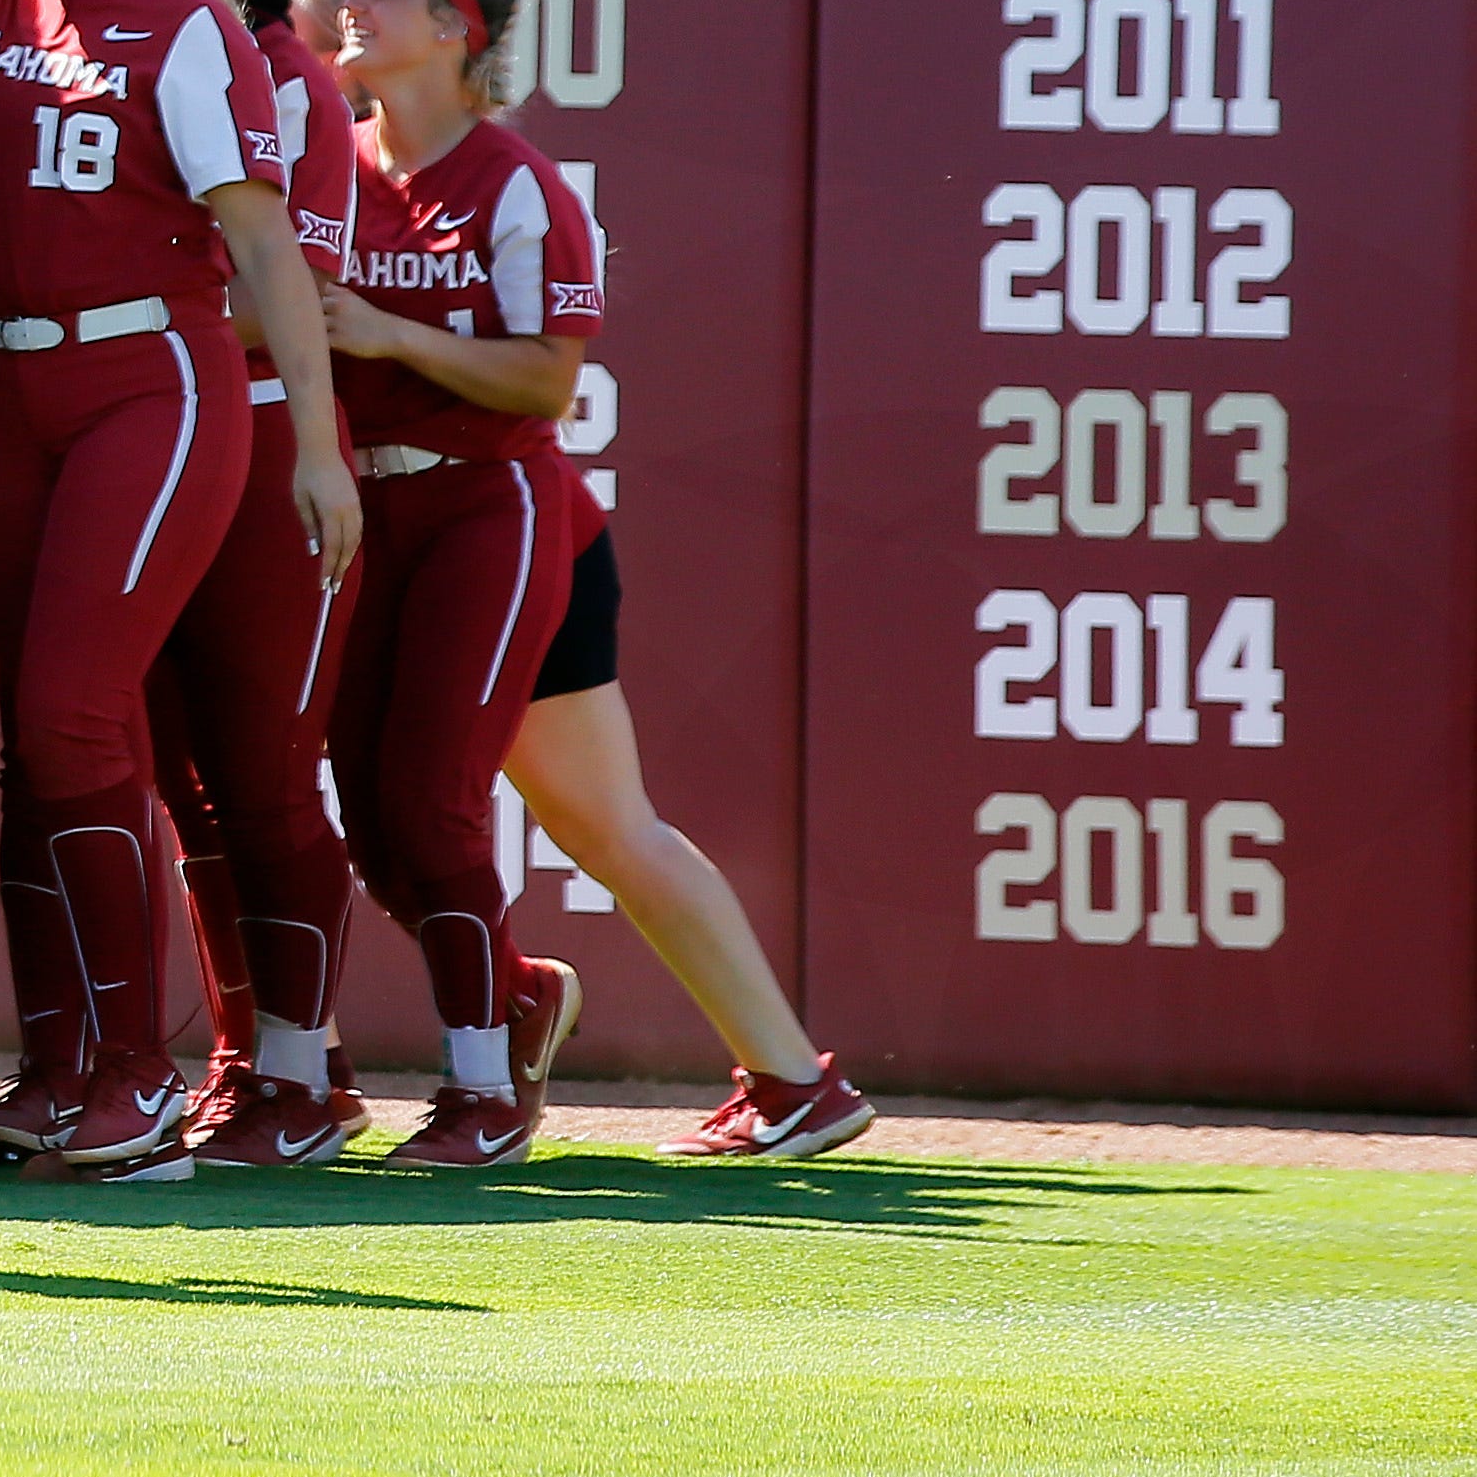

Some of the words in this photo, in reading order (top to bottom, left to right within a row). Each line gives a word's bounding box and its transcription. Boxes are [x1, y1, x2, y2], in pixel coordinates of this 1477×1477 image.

[27, 104, 122, 193] 18
[980, 183, 1293, 339] 2012
[977, 387, 1288, 542] 2013
[975, 590, 1285, 746] 2014
[974, 792, 1285, 948] 2016
